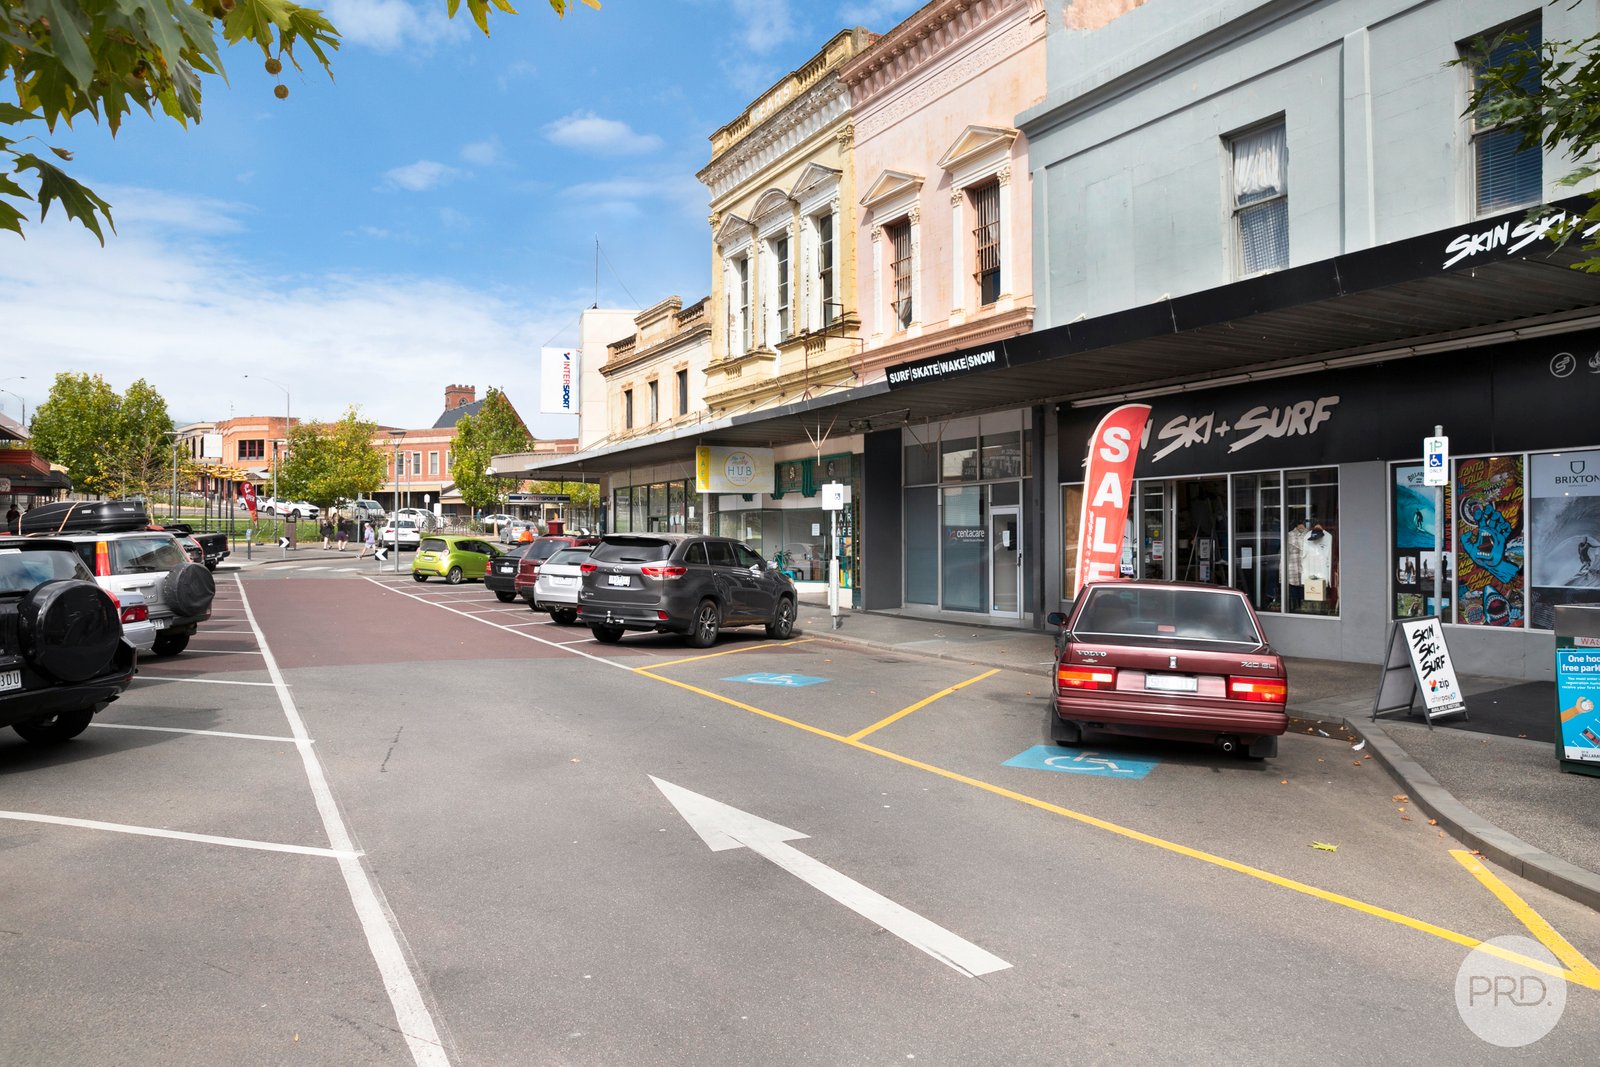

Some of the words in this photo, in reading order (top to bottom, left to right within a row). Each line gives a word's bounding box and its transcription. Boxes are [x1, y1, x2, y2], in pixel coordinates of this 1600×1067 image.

[1443, 221, 1510, 270] SKIN
[562, 360, 571, 410] INTERSPORT
[1227, 396, 1341, 455] SURF
[727, 466, 753, 476] HUB
[1555, 475, 1600, 484] BRIXTON
[1088, 426, 1132, 580] SALE
[956, 529, 985, 538] centacare
[1412, 624, 1434, 649] SKIN
[1076, 649, 1107, 657] VOLVO
[1568, 655, 1585, 663] One
[1421, 655, 1445, 680] SURF
[1562, 664, 1579, 672] free
[1438, 678, 1450, 689] zip
